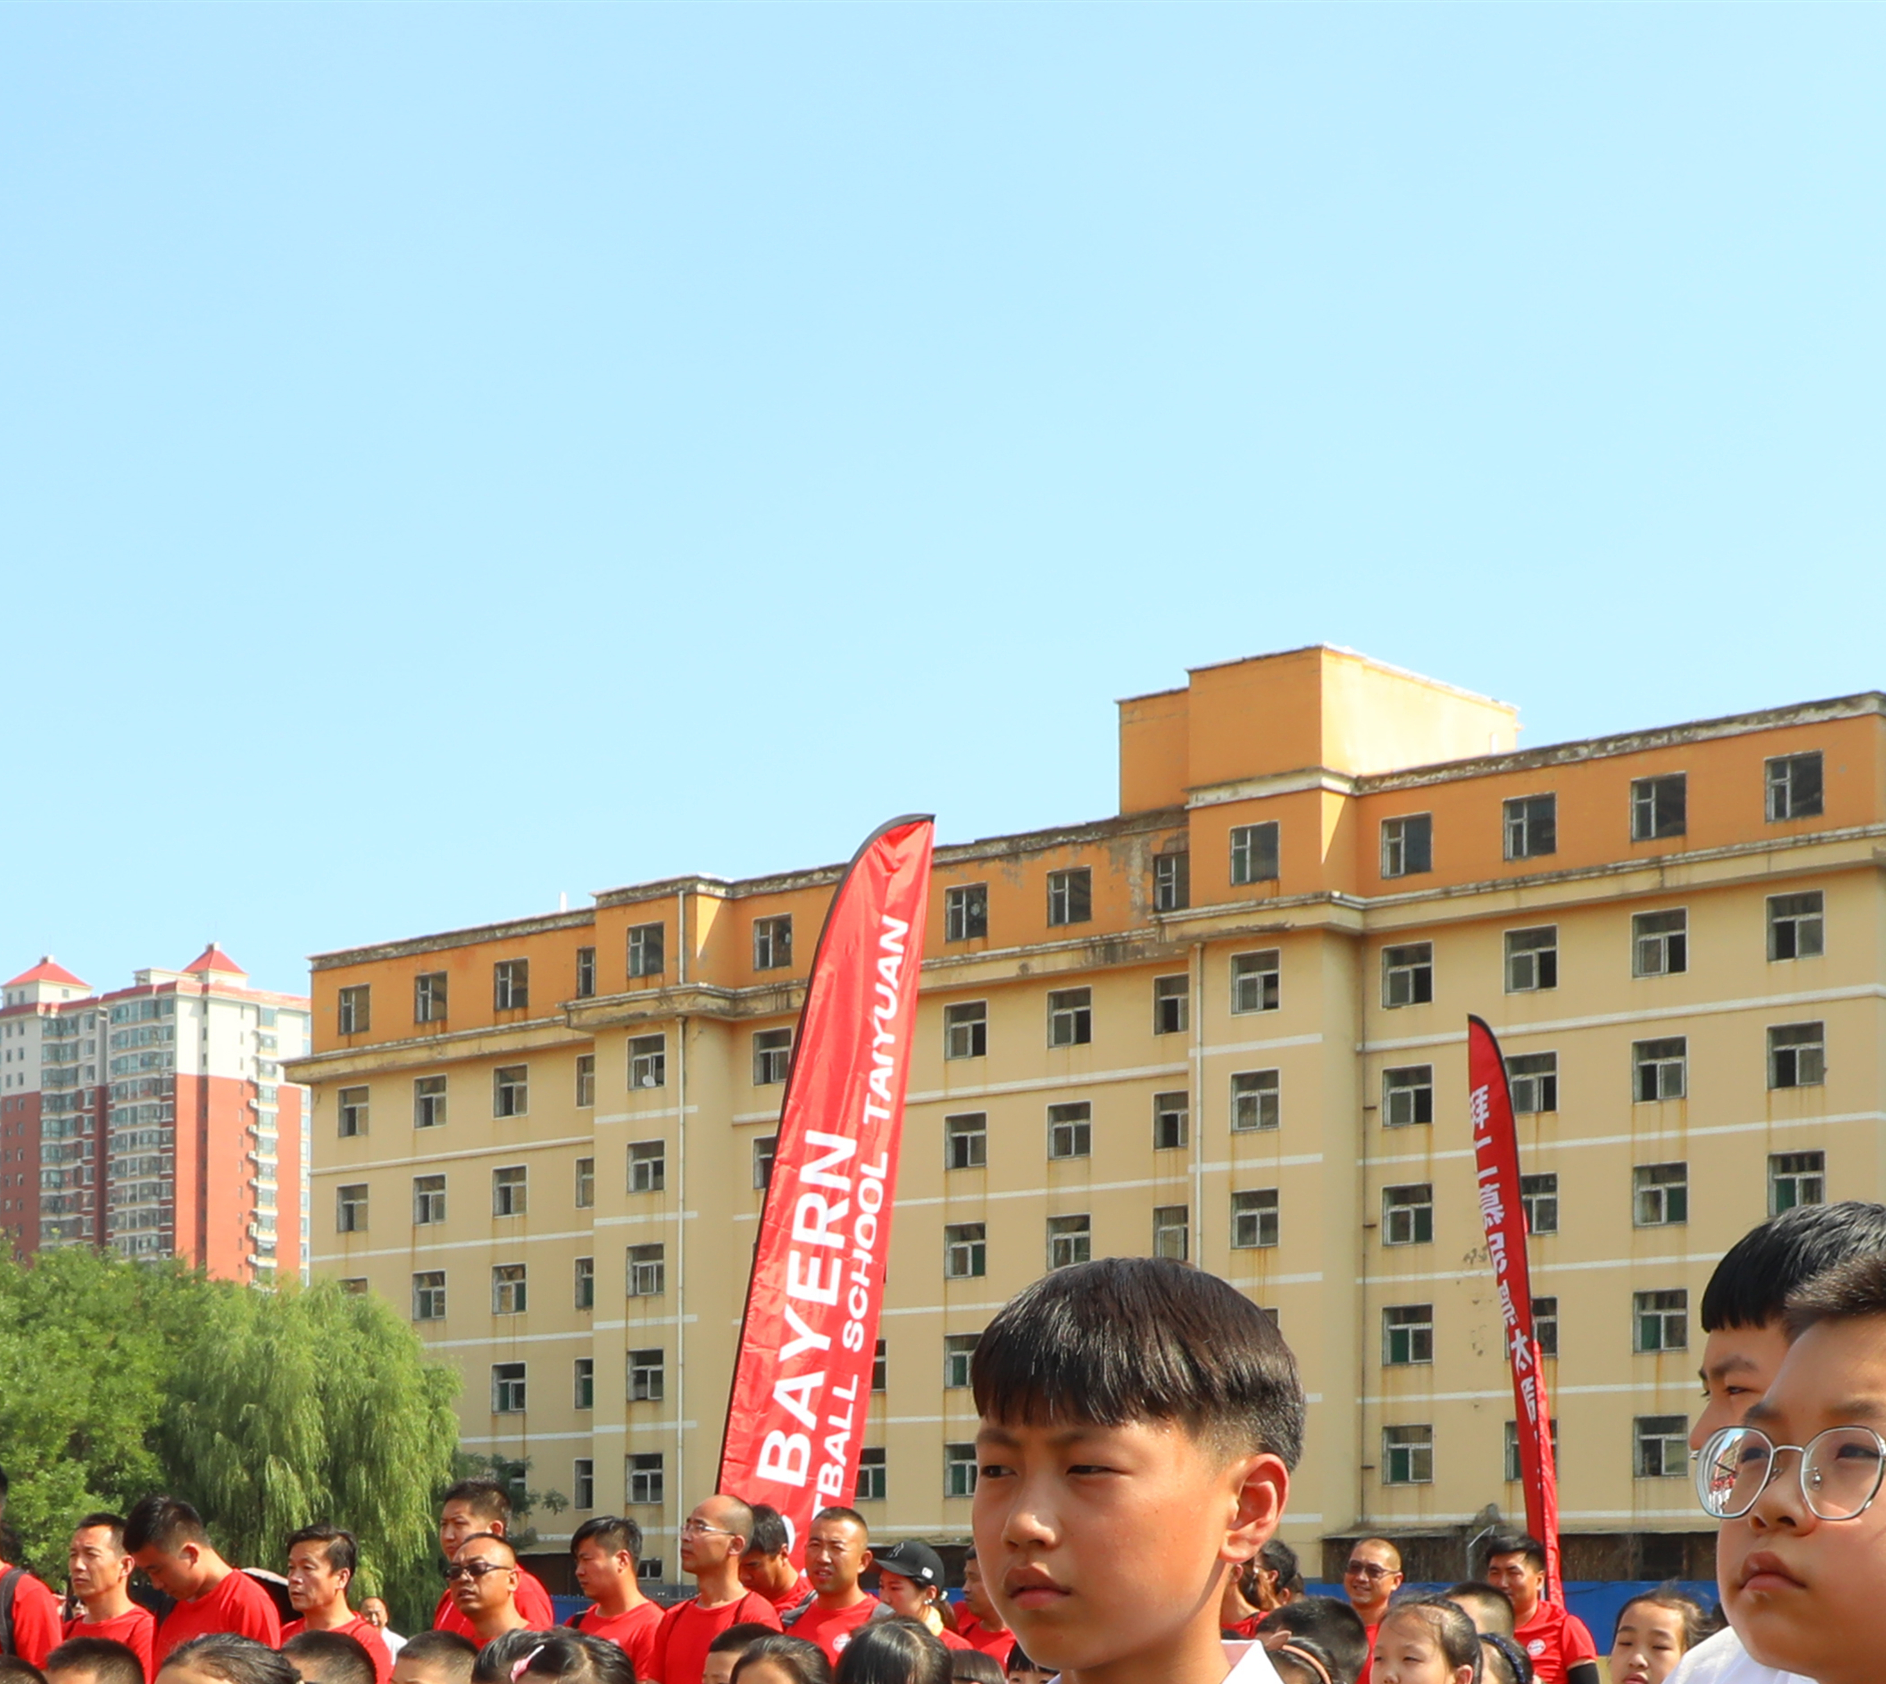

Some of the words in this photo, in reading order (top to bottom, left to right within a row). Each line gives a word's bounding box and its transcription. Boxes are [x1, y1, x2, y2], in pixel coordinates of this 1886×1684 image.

[863, 914, 909, 1125] TAIYUAN
[756, 1129, 858, 1488] BAYERN
[842, 1151, 888, 1353] SCHOOL
[811, 1374, 858, 1521] TBALL
